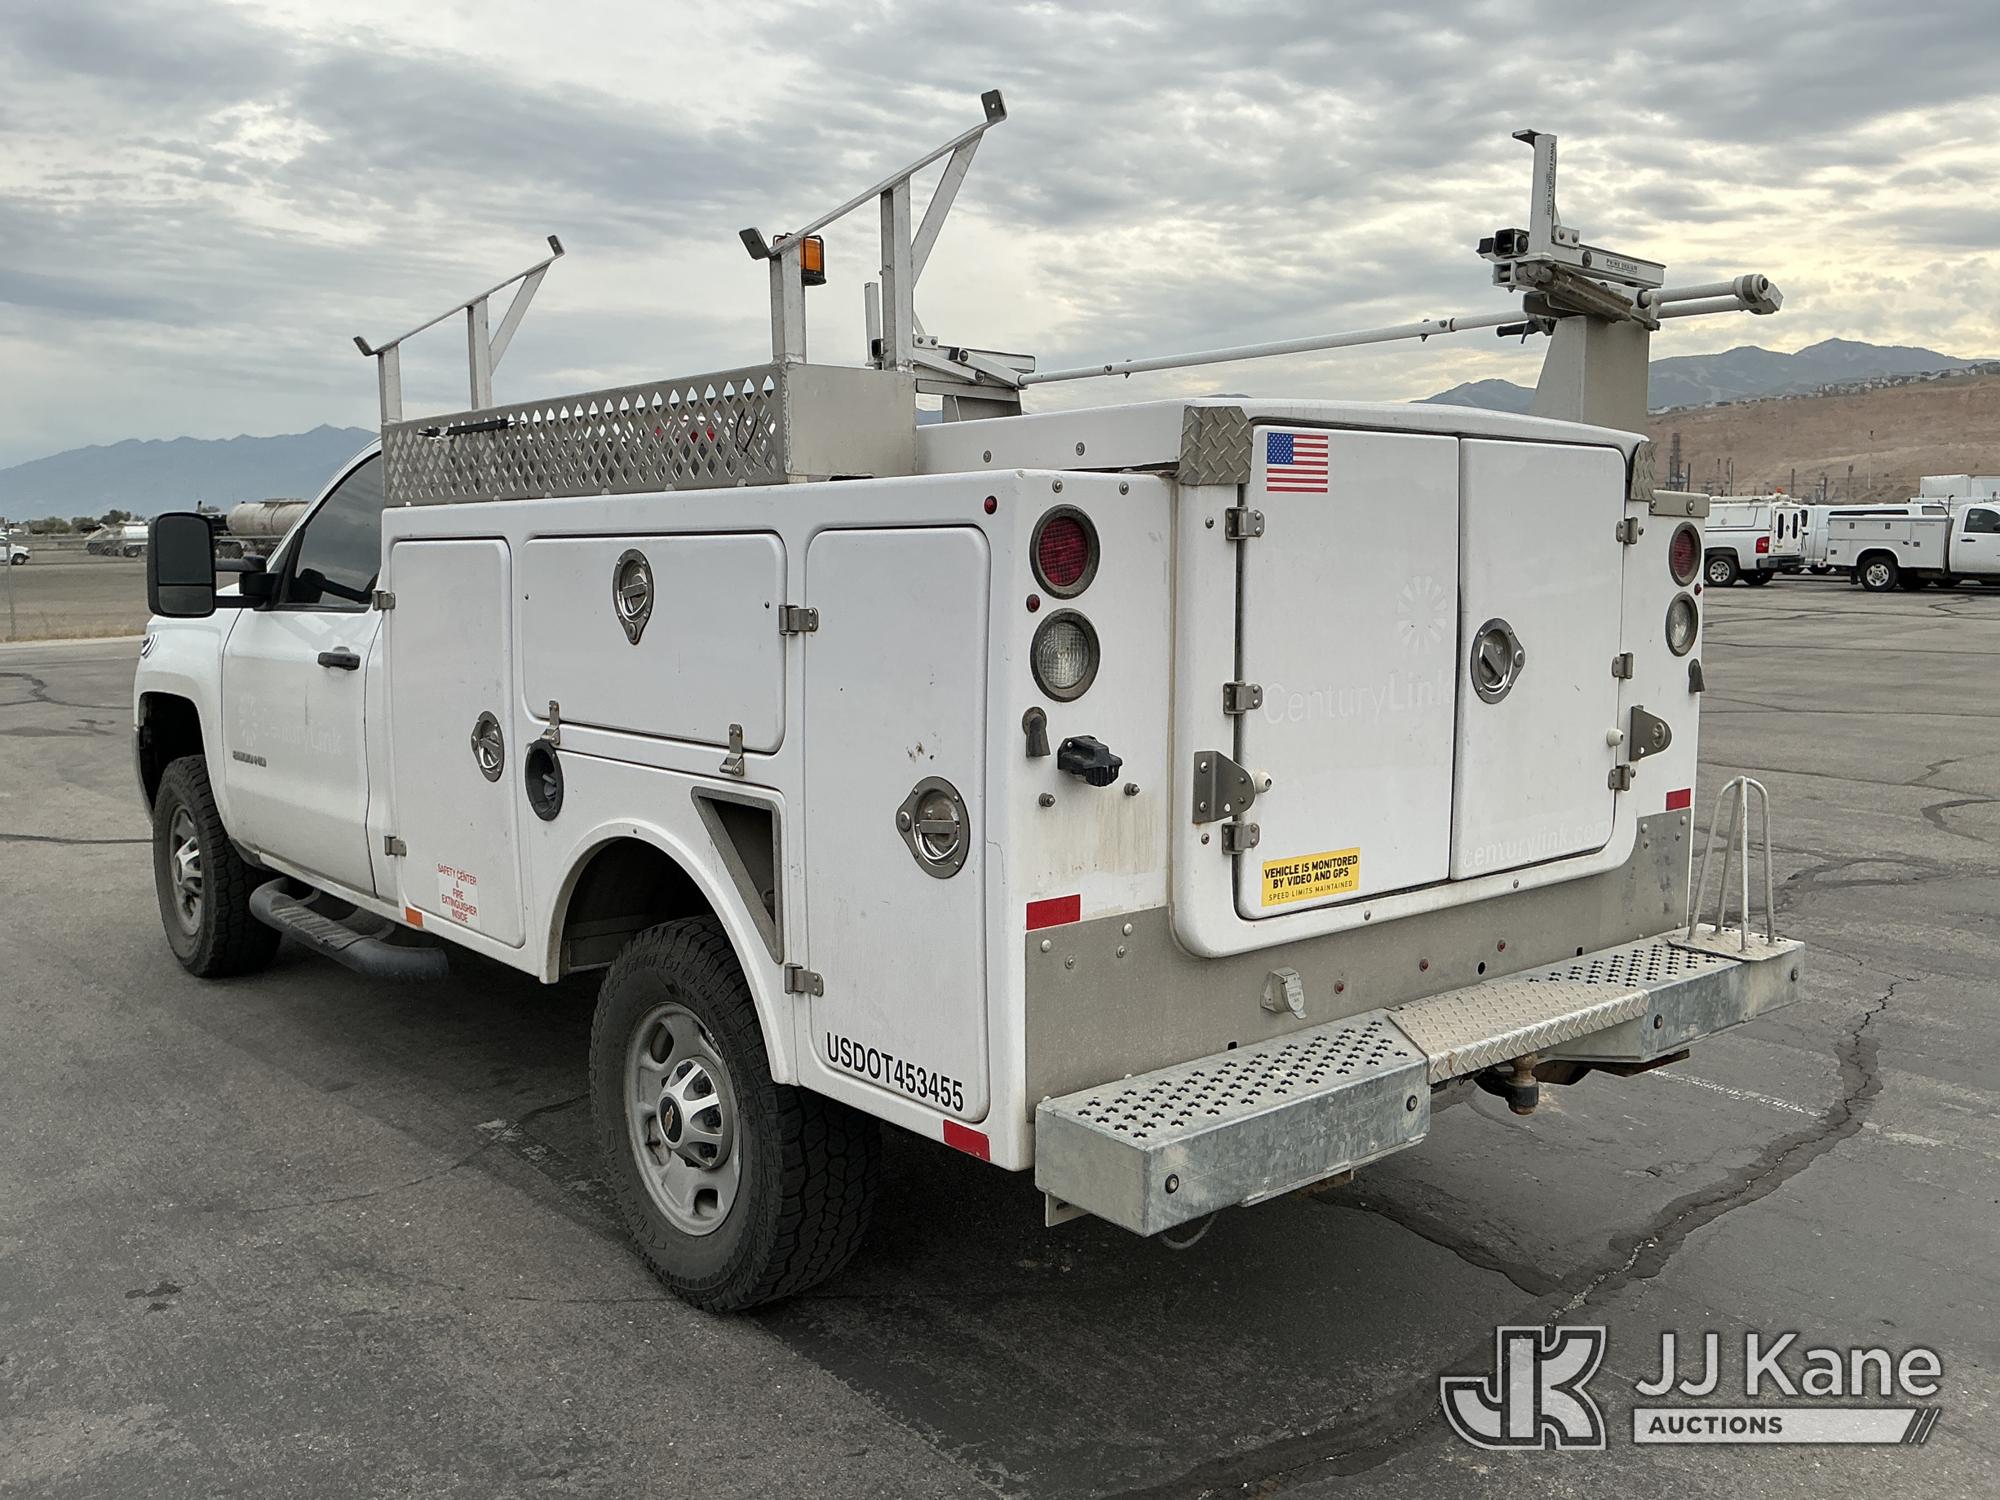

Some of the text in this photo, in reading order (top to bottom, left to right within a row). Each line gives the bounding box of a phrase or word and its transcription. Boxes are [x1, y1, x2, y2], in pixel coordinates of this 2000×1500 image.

[437, 863, 477, 885] SAFETY CENTER
[1264, 855, 1358, 879] VEHICLE IS MONITORED
[1272, 867, 1349, 889] BY VIDEO AND GPS
[452, 888, 465, 900] FIRE
[1268, 880, 1353, 901] SPEED LIMITS MAINTAINED
[826, 1031, 964, 1112] USDOT453455
